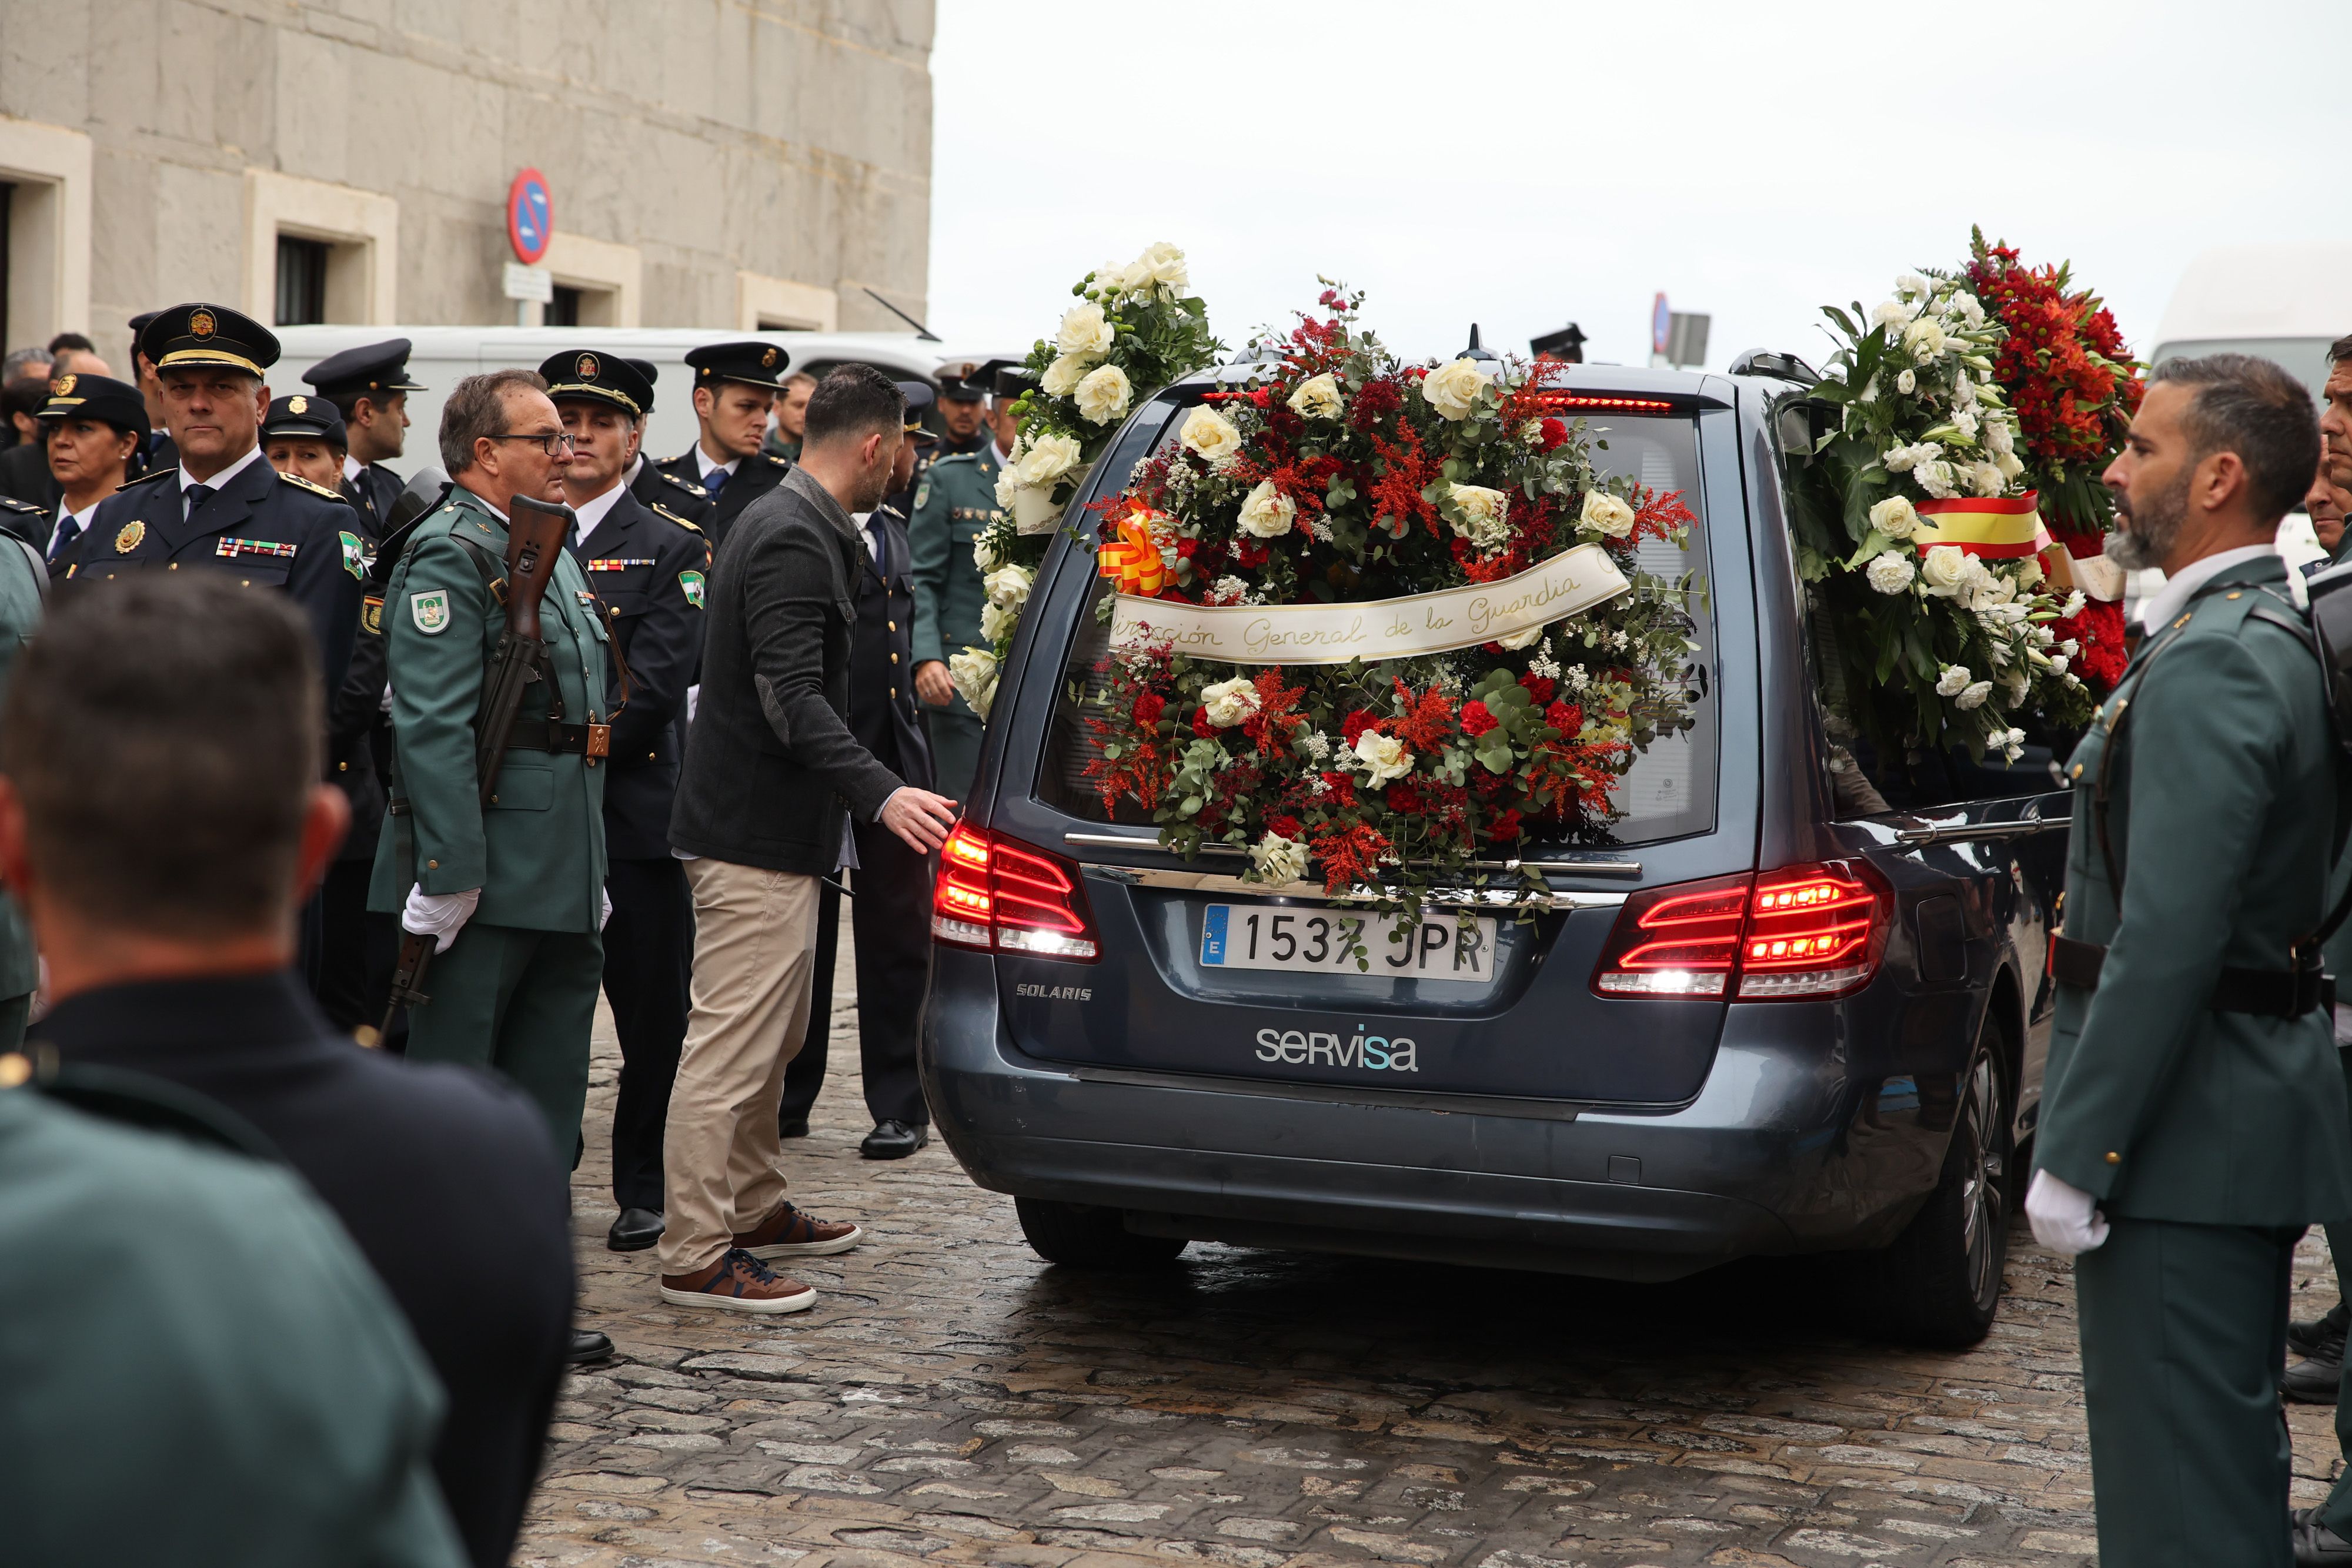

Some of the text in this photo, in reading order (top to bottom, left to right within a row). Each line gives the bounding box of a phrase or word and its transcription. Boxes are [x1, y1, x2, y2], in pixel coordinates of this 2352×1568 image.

[1244, 615, 1368, 656] General
[1385, 613, 1413, 638] de
[1425, 606, 1454, 630] la
[1468, 576, 1582, 634] Guardia
[1209, 941, 1220, 954] E
[1247, 914, 1480, 972] 1537 JPR
[1016, 984, 1092, 1001] SOLARIS
